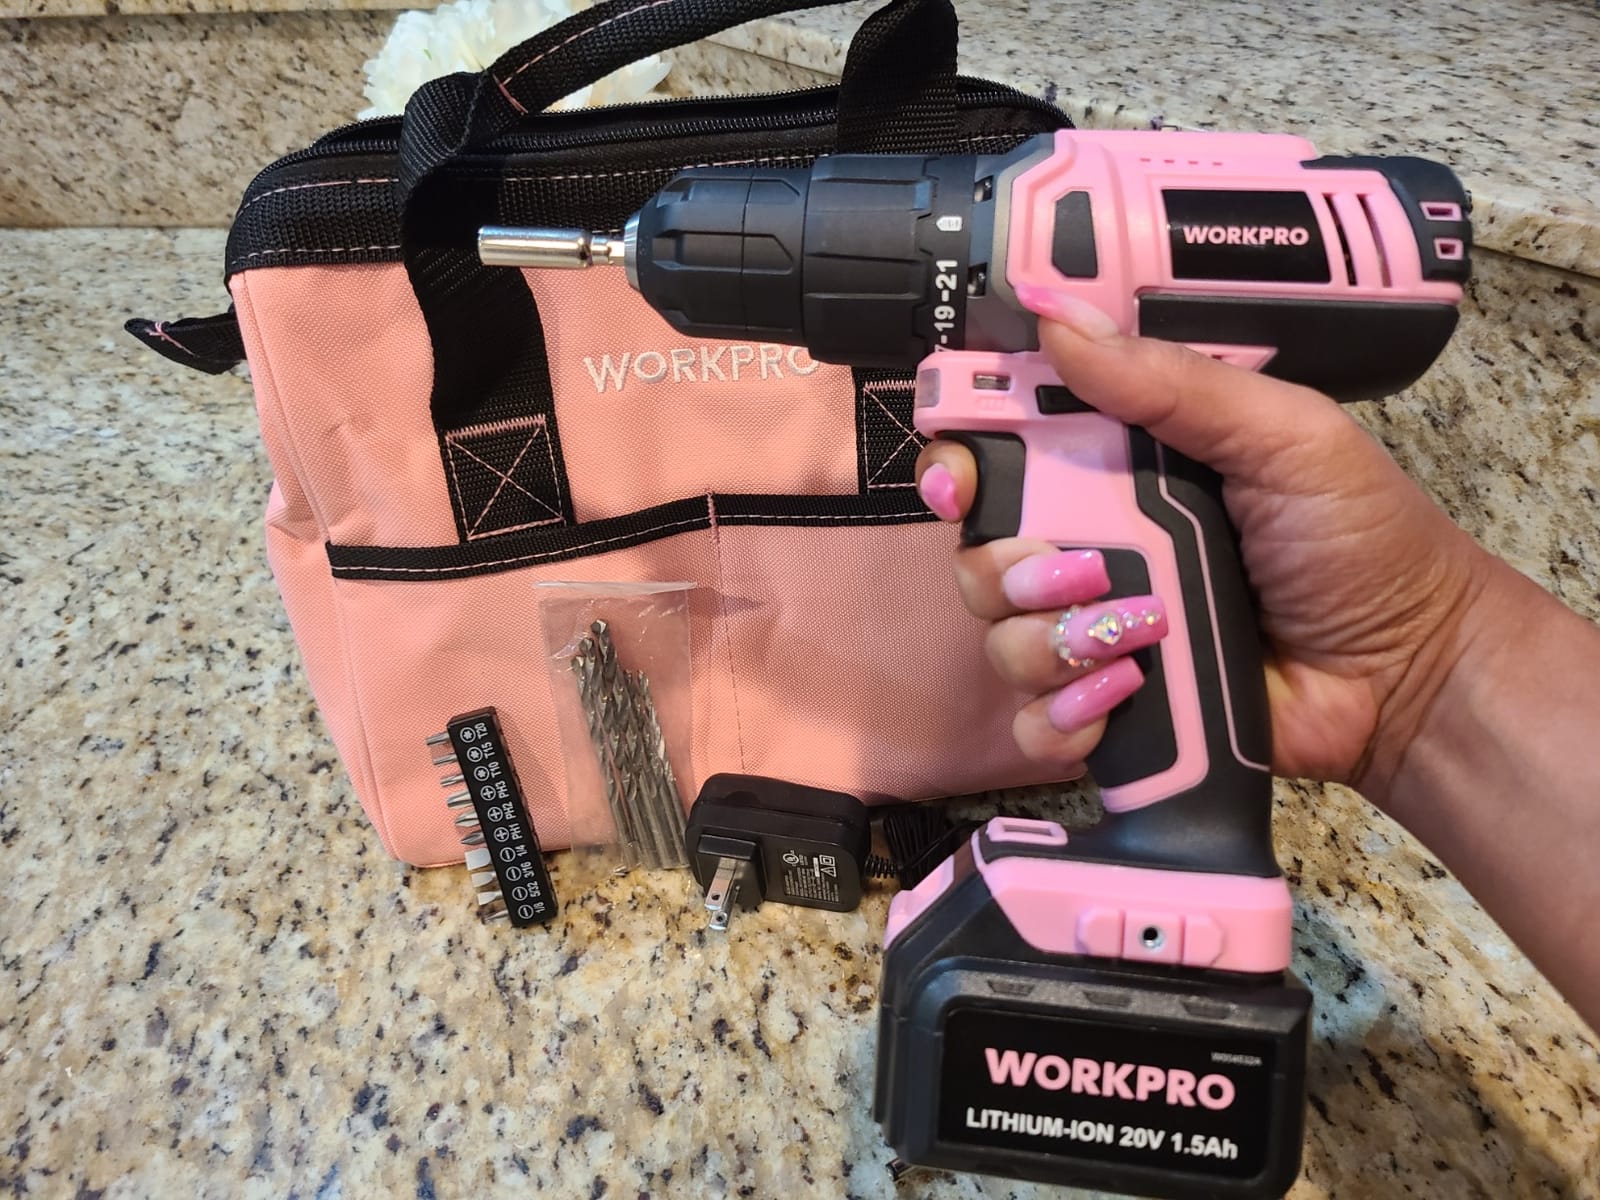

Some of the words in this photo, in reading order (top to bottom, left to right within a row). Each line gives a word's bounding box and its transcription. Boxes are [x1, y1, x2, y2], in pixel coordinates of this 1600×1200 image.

[1182, 225, 1309, 246] WORKPRO
[583, 344, 820, 393] WORKPRO
[474, 722, 488, 740] T20
[481, 742, 495, 759] T15
[488, 761, 502, 778] T10
[494, 780, 510, 799] PH3
[501, 801, 517, 820] PH2
[508, 823, 523, 840] PH1
[514, 844, 528, 857] 1/4
[520, 861, 535, 879] 3/16
[527, 880, 541, 898] 5/32
[533, 901, 546, 913] 1/8
[984, 1047, 1236, 1111] WORKPRO
[966, 1107, 1115, 1145] LITHIUM-ION
[1118, 1125, 1166, 1150] 20V
[1170, 1131, 1239, 1160] 1.5Ah
